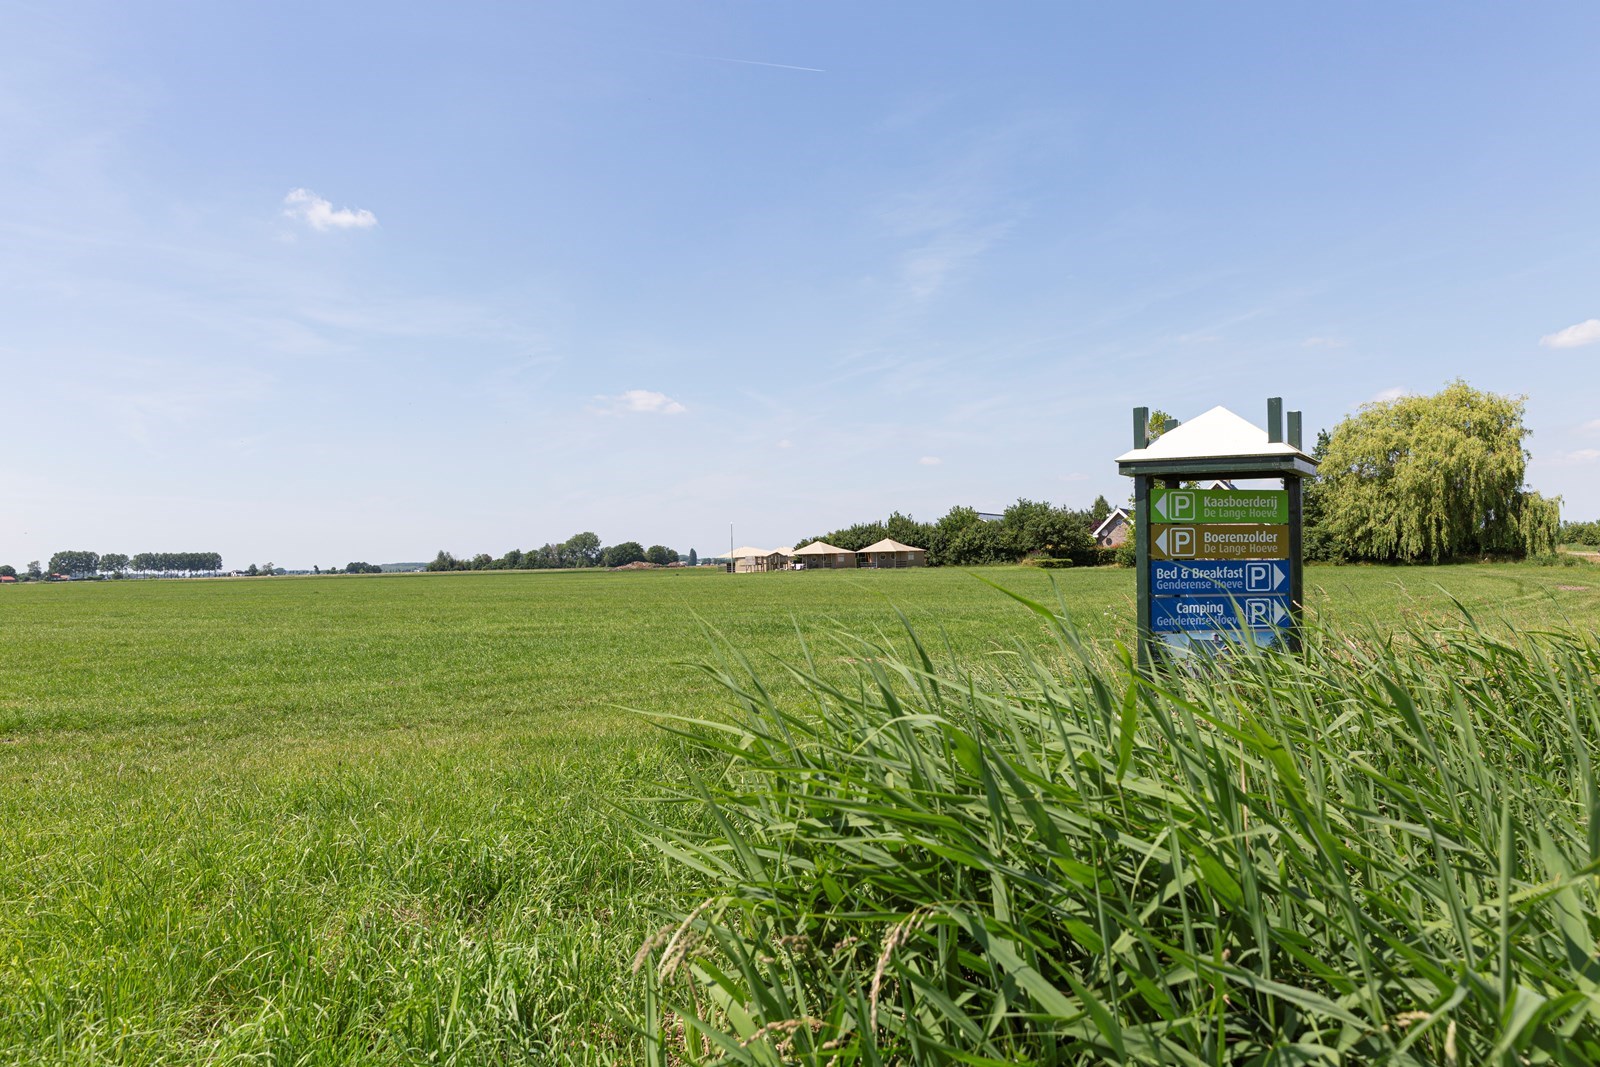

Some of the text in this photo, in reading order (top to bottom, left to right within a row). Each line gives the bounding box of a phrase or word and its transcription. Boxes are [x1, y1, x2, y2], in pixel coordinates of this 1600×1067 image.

[1175, 496, 1190, 516] P
[1204, 496, 1278, 511] Kaasboerderij
[1204, 508, 1278, 520] De Lange Hoeve
[1176, 532, 1190, 552] P
[1204, 531, 1278, 542] Boerenzolder
[1204, 544, 1278, 556] De Lange Hoeve
[1156, 567, 1243, 579] Bed & Breakfast
[1251, 567, 1266, 588] P
[1156, 580, 1212, 590] Genderense
[1176, 602, 1224, 616] Camping
[1251, 603, 1266, 623] P
[1156, 615, 1240, 626] Genderense Hoev
